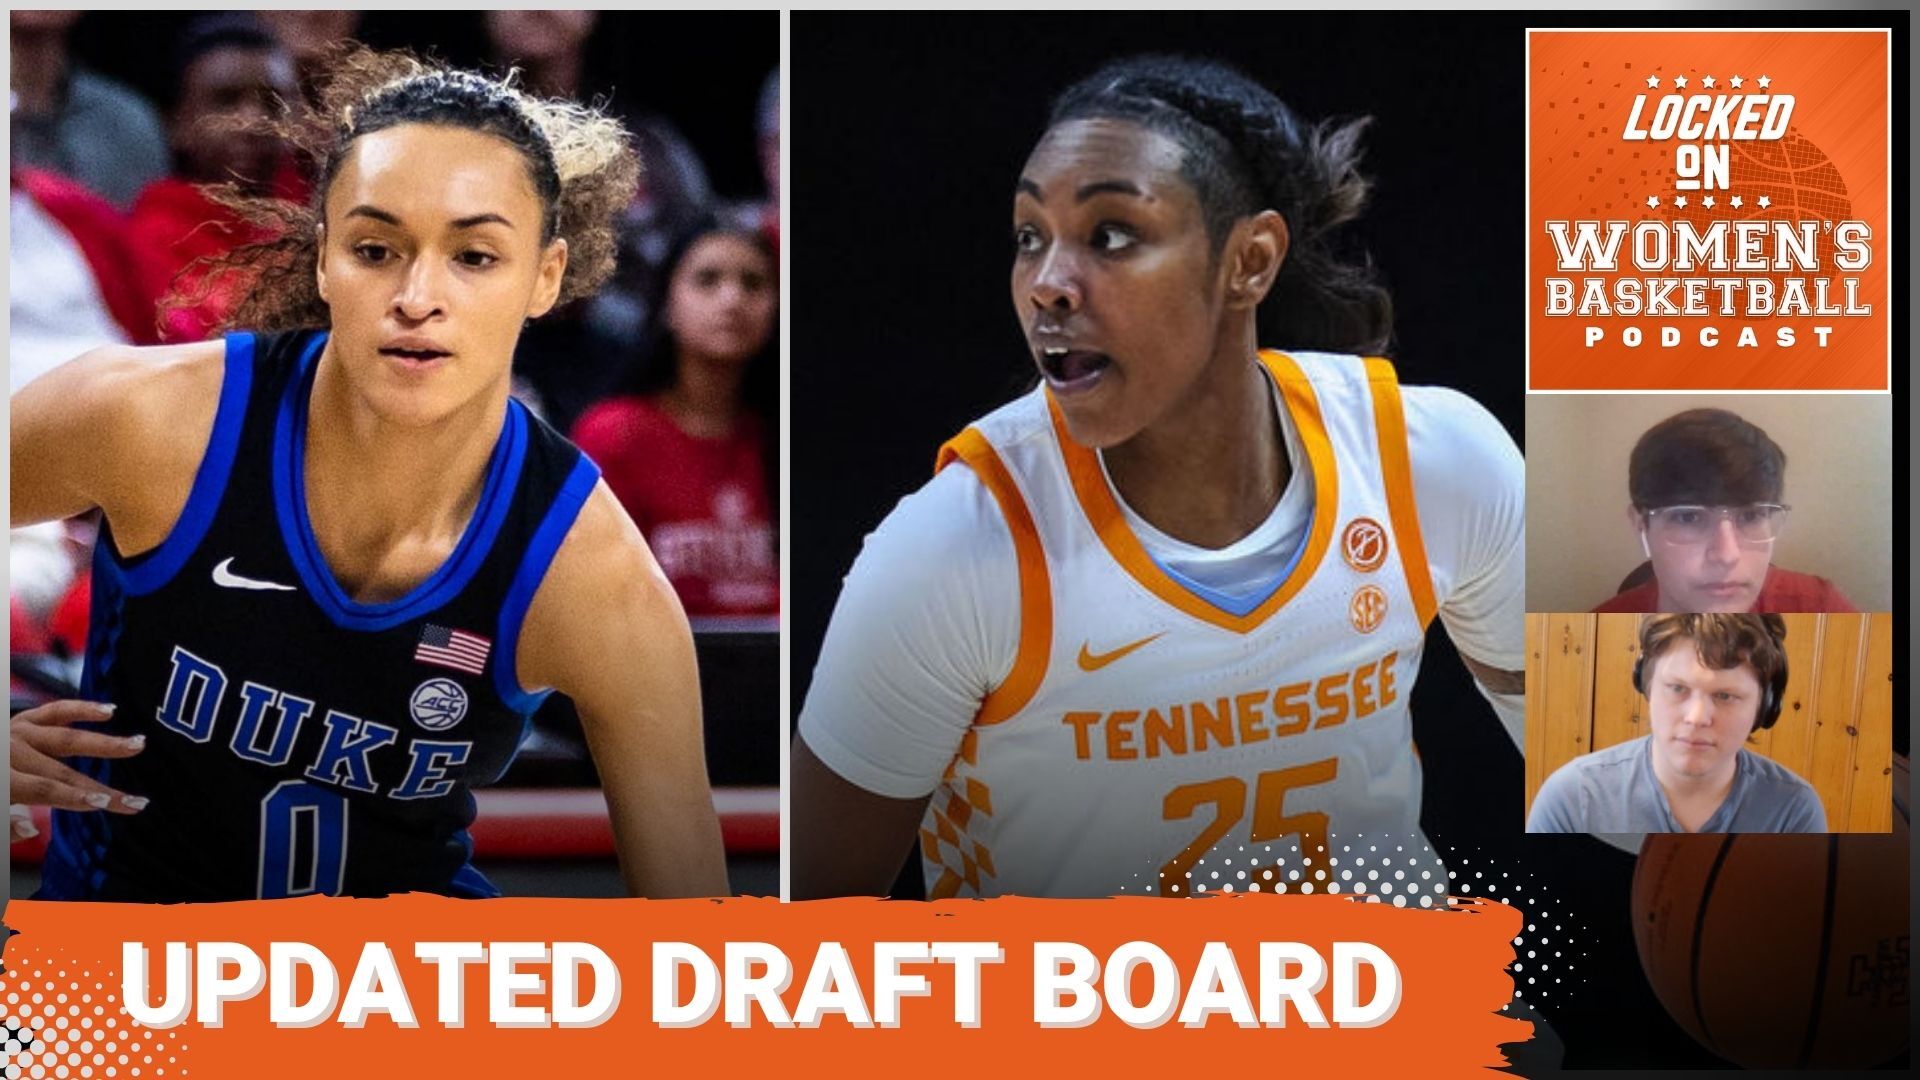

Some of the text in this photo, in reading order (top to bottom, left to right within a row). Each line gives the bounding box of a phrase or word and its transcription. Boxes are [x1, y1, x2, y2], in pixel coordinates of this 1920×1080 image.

[157, 645, 473, 801] DUKE
[1062, 650, 1399, 762] TENNESSEE
[1158, 757, 1334, 899] 25
